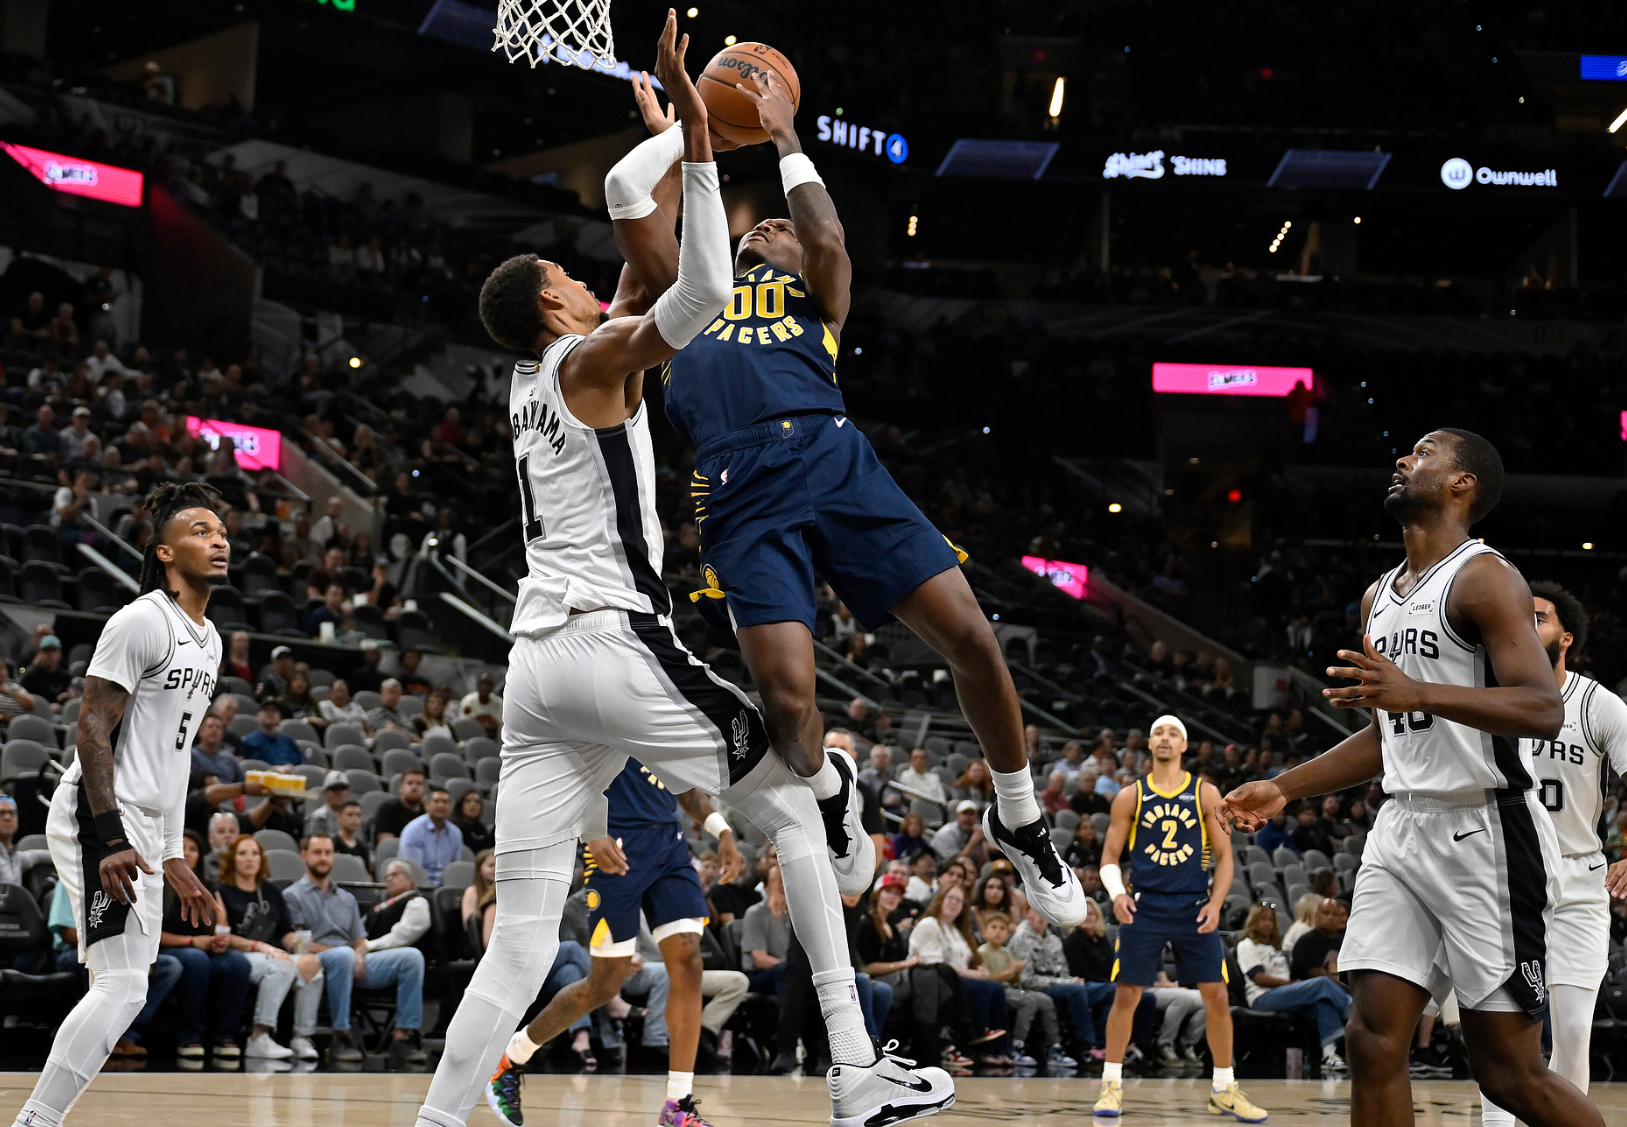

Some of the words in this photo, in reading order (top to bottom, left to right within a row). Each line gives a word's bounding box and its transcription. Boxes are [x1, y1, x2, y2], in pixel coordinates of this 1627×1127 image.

[1476, 167, 1557, 186] Ownwell
[724, 281, 785, 320] 00
[703, 315, 804, 345] PACERS
[518, 452, 547, 547] 1
[1412, 603, 1432, 611] LEDGER
[1374, 627, 1440, 661] PURS
[164, 667, 216, 700] SPURS
[175, 710, 193, 752] 5
[1141, 803, 1197, 830] INDIANA
[1161, 820, 1178, 849] 2
[1144, 843, 1194, 867] PACERS
